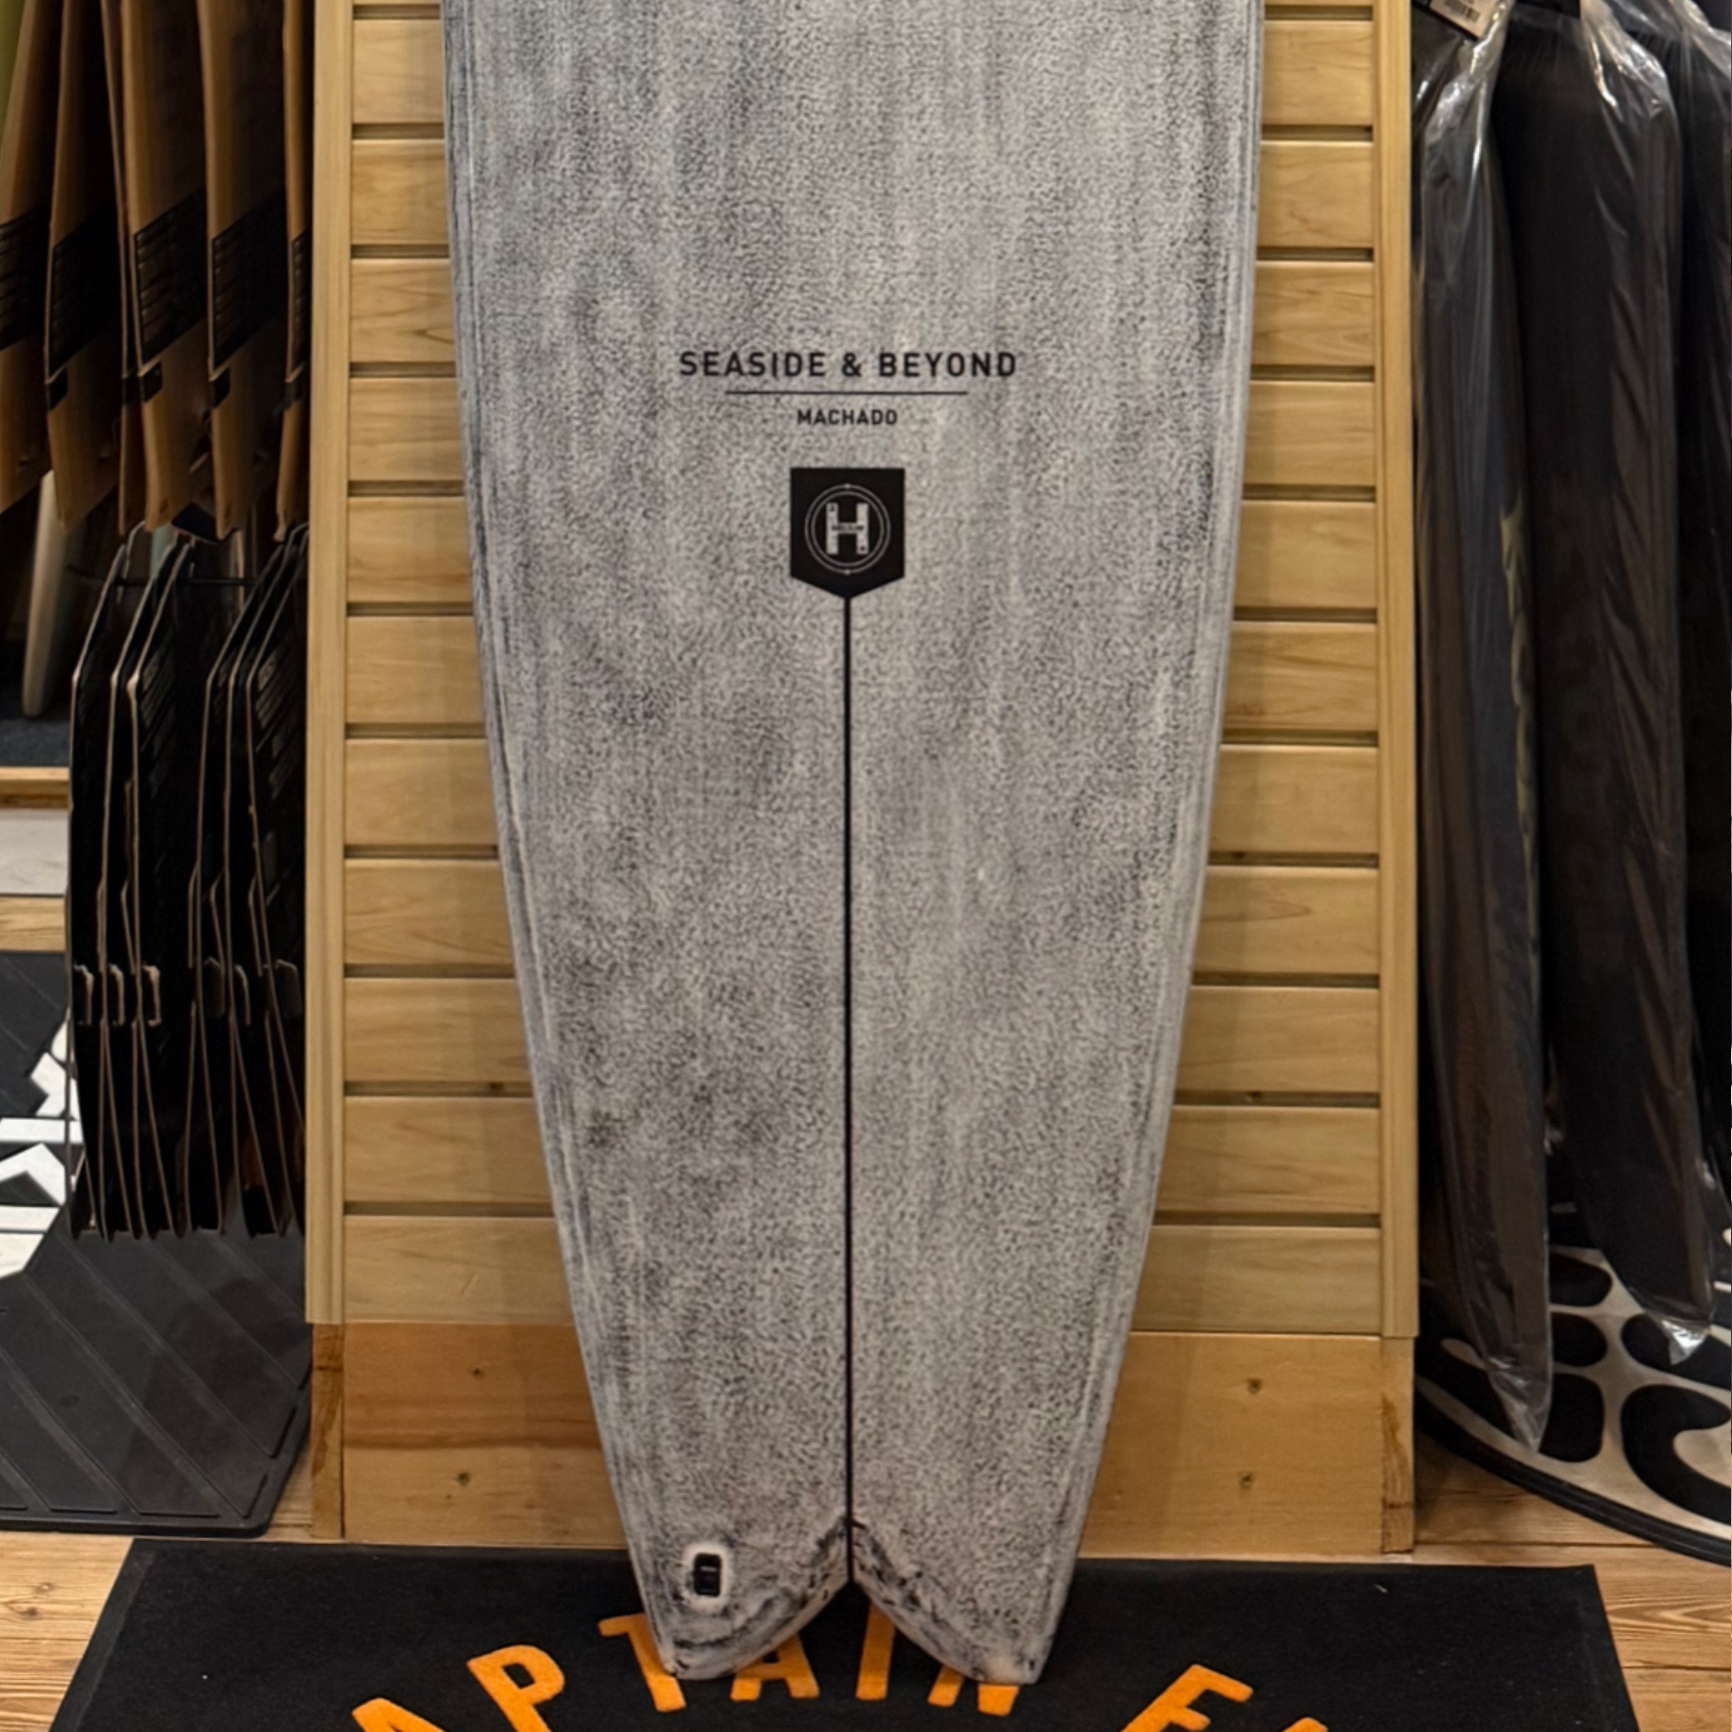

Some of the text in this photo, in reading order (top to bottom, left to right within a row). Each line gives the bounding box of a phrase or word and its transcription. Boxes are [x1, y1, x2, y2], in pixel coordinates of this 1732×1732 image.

[679, 351, 1017, 378] SEASIDE & BEYOND
[797, 409, 898, 426] MACHADO
[825, 502, 870, 555] H
